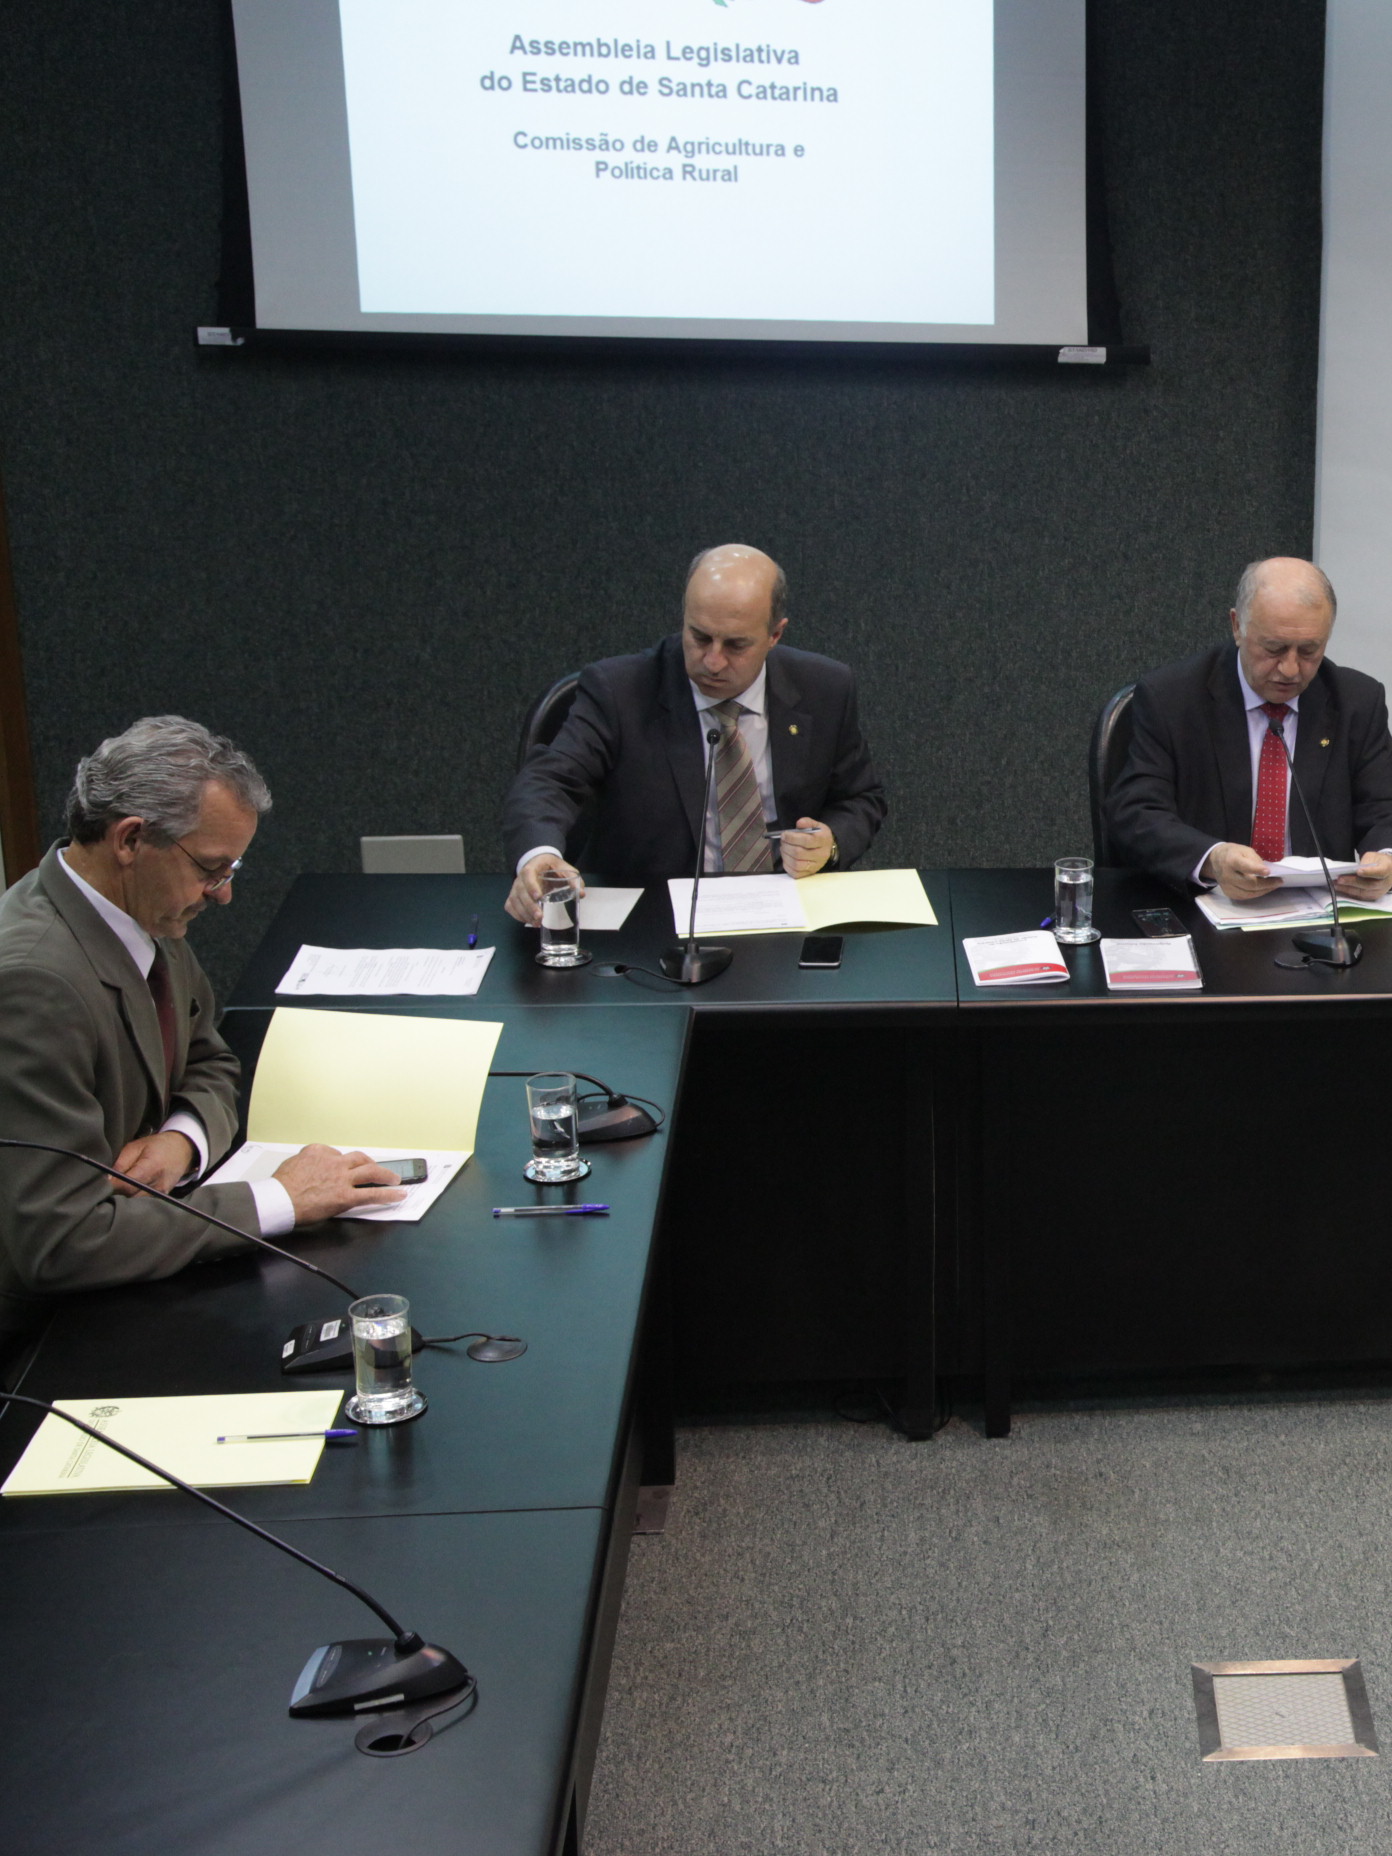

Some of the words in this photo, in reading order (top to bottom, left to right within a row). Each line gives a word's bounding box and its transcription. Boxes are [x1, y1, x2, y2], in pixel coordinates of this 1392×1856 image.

[509, 34, 656, 61] Assembleia
[666, 40, 800, 68] Legislativa
[480, 70, 512, 92] do
[522, 72, 609, 95] Estado
[619, 75, 648, 96] de
[658, 77, 727, 99] Santa
[737, 79, 838, 103] Catarina
[513, 131, 625, 153] Comissão
[633, 135, 658, 154] de
[666, 136, 786, 159] Agricultura
[793, 143, 805, 157] e
[595, 160, 674, 181] Política
[682, 163, 739, 183] Rural
